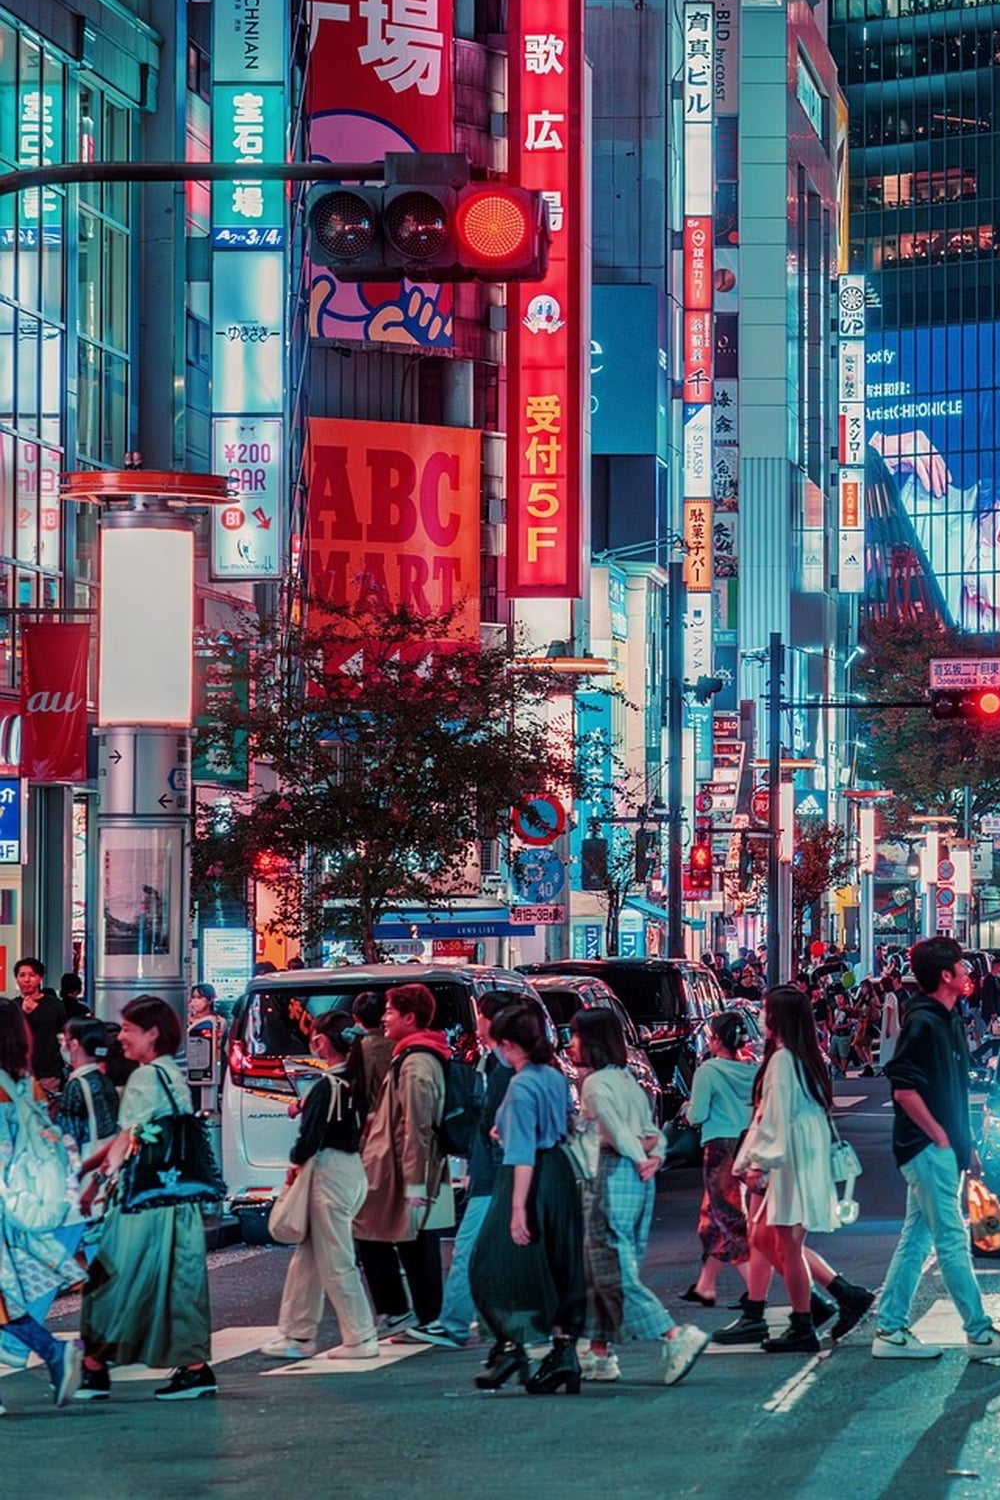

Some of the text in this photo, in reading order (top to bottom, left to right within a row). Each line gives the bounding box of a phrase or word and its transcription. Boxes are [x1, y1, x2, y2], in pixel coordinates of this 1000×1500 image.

[715, 65, 726, 101] COAST
[227, 325, 270, 343] ゆきざき
[687, 369, 710, 396] 千
[224, 443, 271, 464] ¥200
[849, 418, 862, 461] スシロー
[525, 394, 562, 563] 受付5F
[308, 445, 461, 548] ABC
[226, 511, 241, 526] B1
[689, 507, 706, 582] 駄菓子バー
[308, 551, 461, 616] MART
[934, 662, 999, 676] 道玄坂二丁目東
[27, 690, 82, 713] au
